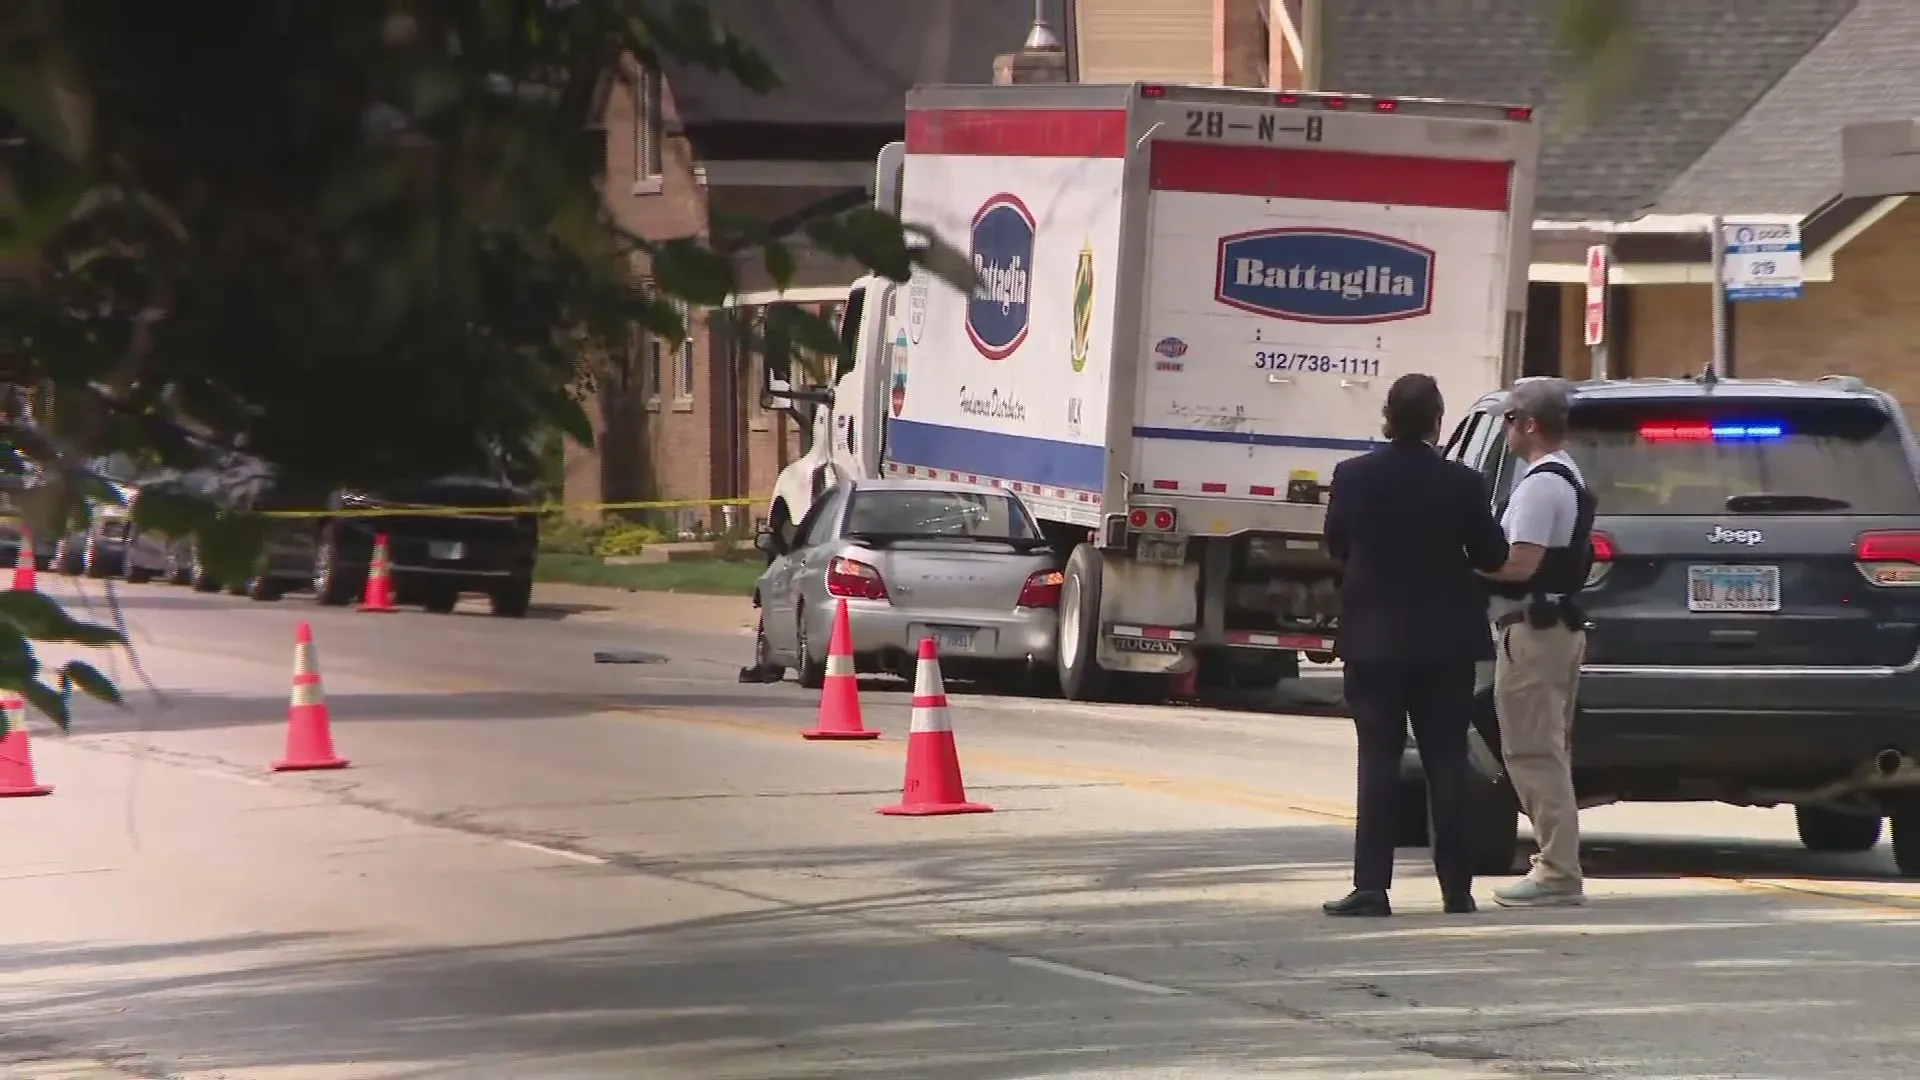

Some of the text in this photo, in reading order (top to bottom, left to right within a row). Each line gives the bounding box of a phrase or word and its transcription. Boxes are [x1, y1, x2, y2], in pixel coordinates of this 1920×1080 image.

[1235, 257, 1414, 300] Battaglia
[1255, 351, 1380, 376] 312/738-1111
[1706, 525, 1764, 546] Jeep
[1116, 638, 1178, 653] HOGAN
